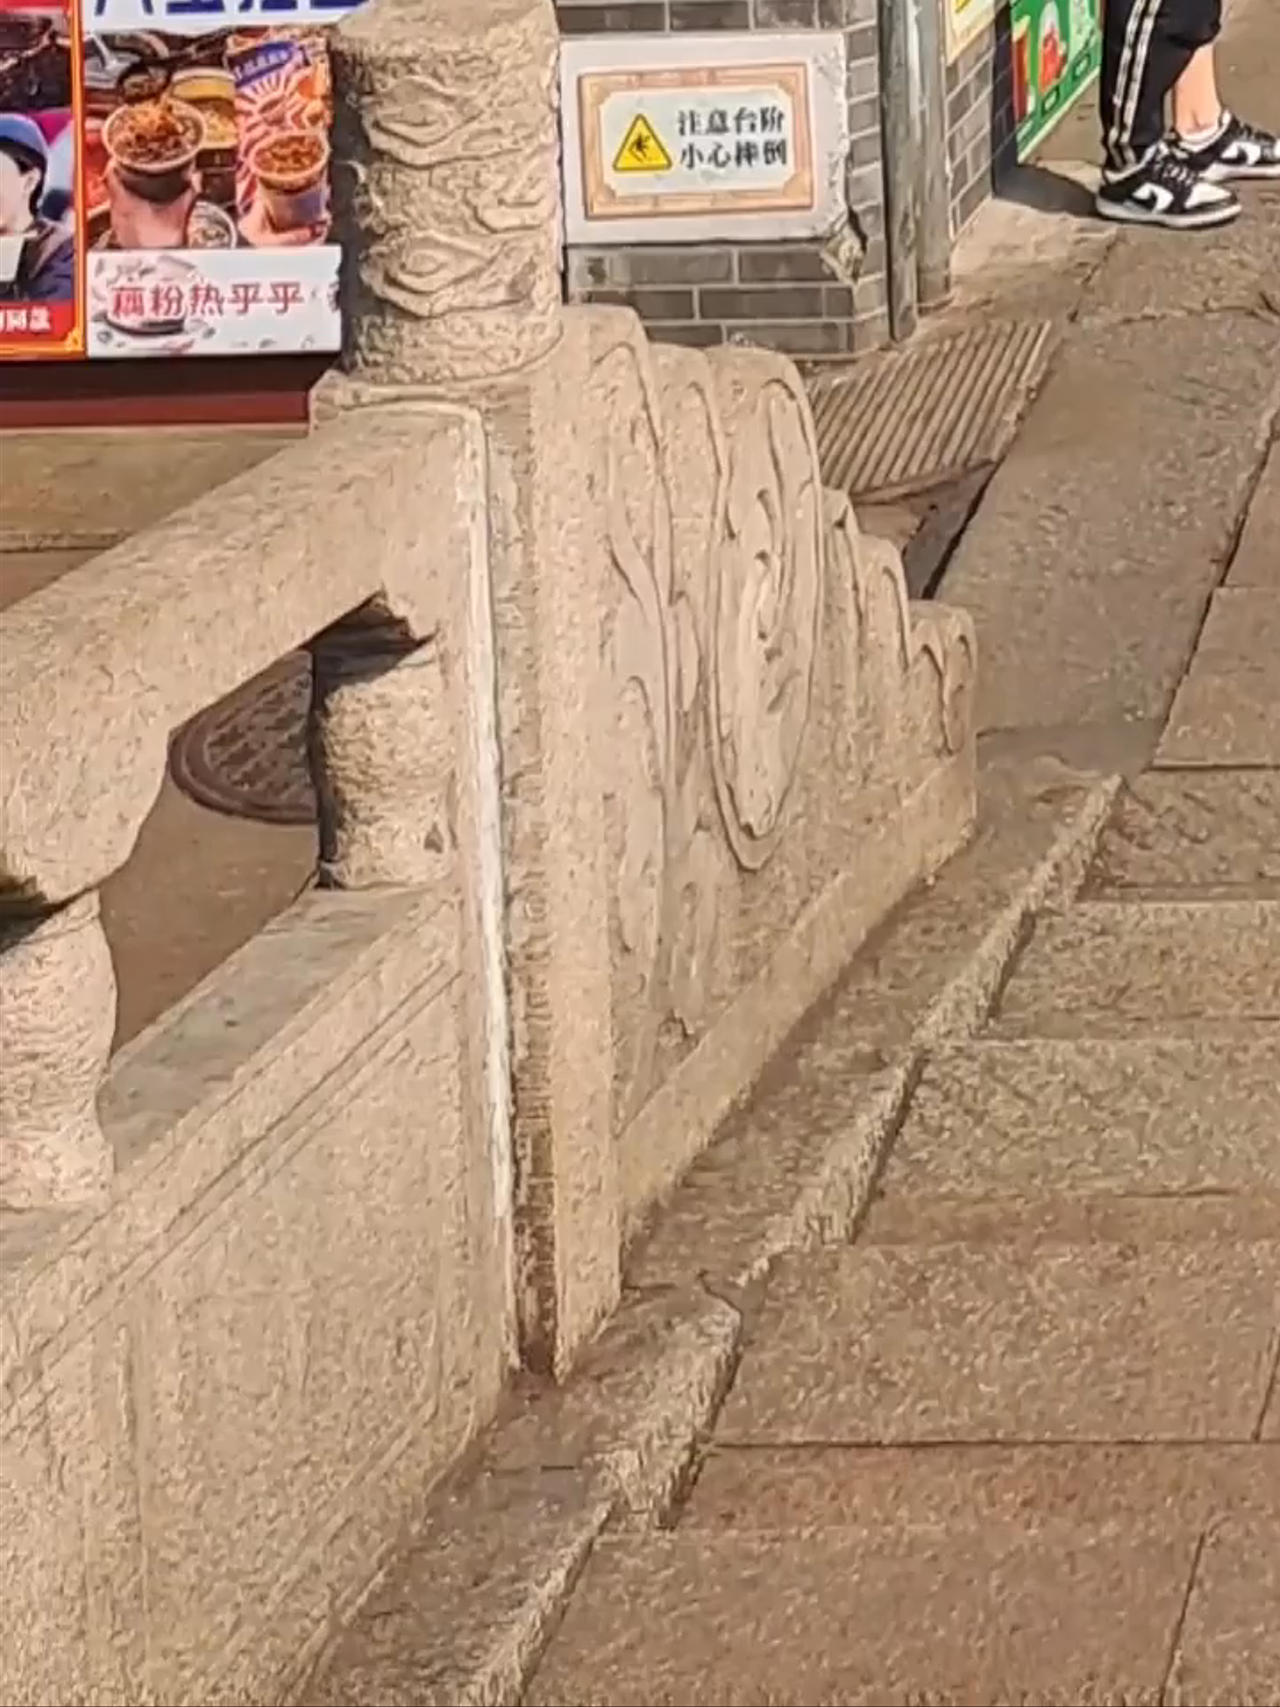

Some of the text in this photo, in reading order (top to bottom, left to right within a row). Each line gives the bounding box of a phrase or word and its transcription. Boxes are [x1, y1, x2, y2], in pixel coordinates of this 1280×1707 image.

[678, 105, 786, 137] 注意台阶
[111, 281, 305, 318] 藕粉热乎乎
